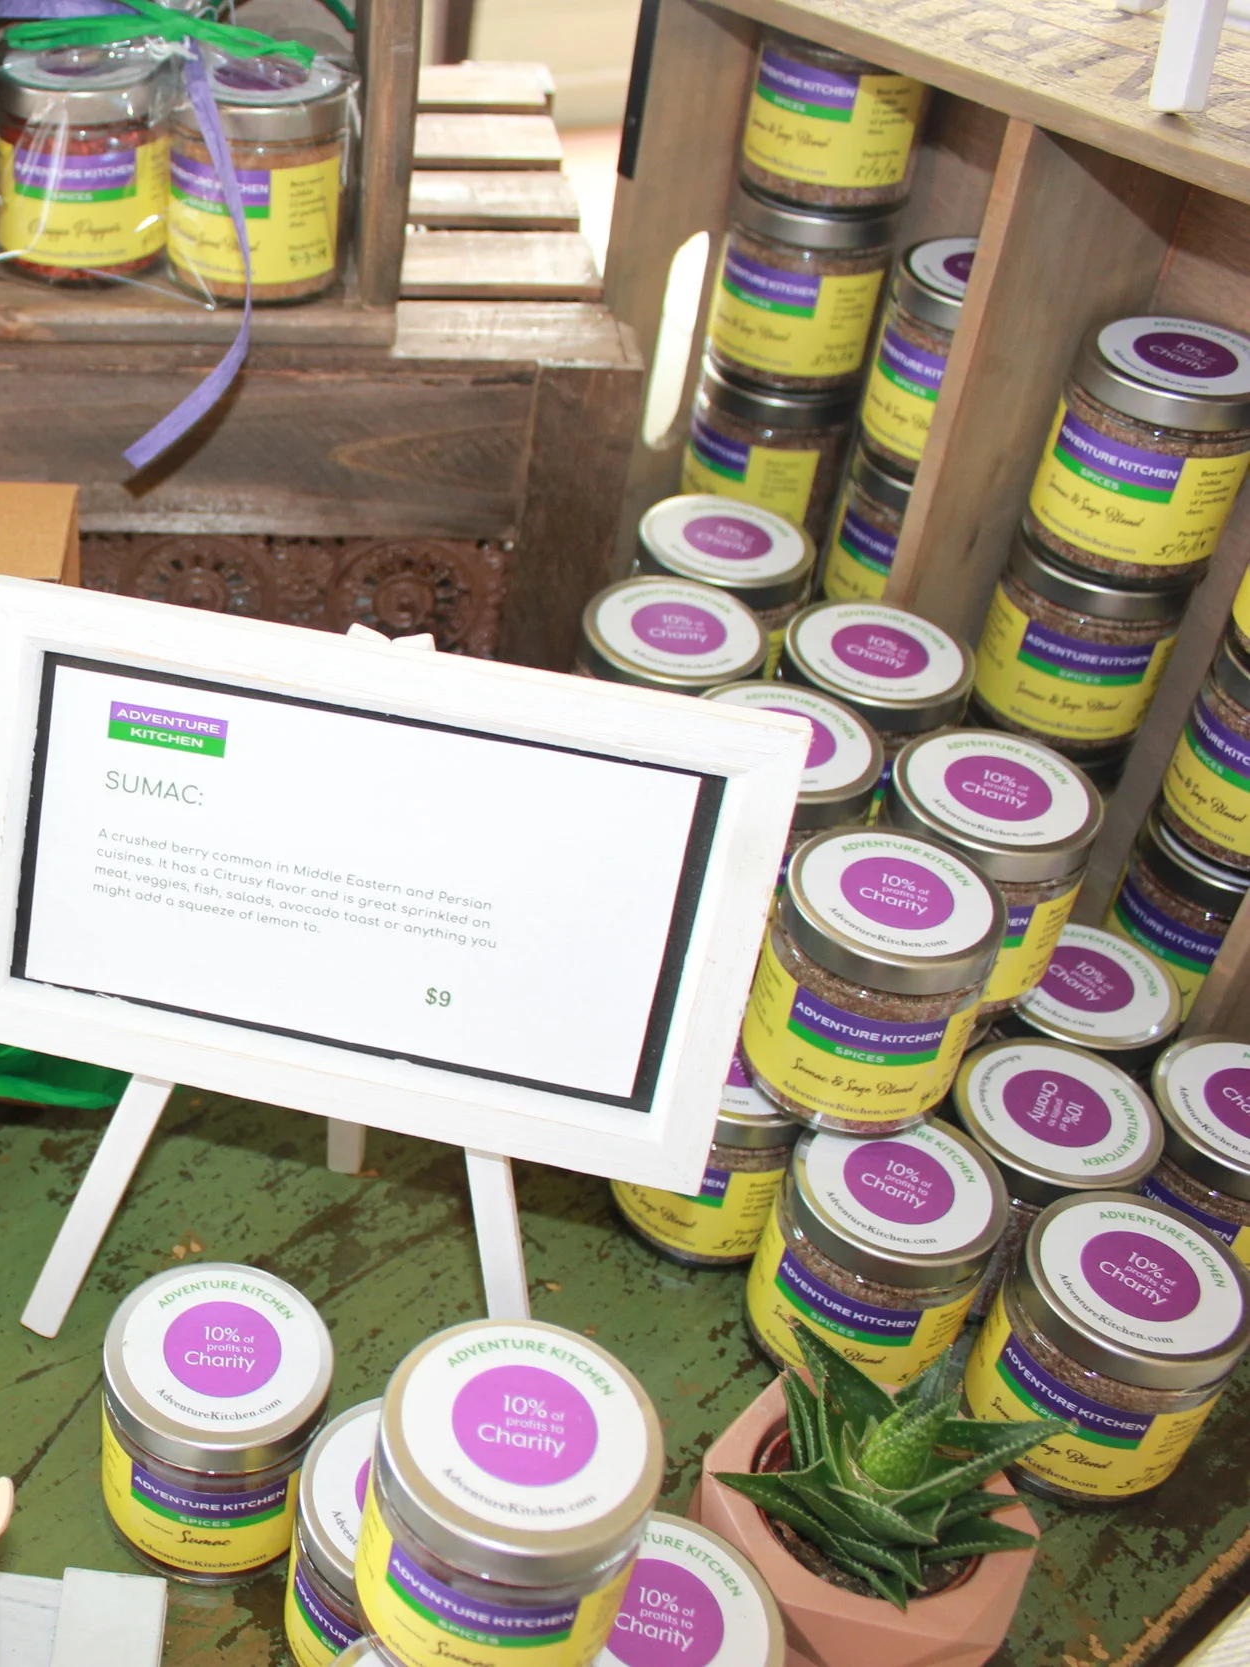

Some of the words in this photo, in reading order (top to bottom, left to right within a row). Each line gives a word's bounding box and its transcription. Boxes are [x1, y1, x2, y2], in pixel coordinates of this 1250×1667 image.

[803, 79, 856, 98] KITCHEN
[87, 163, 135, 178] KITCHEN
[767, 277, 818, 297] KITCHEN
[1149, 344, 1207, 371] Charity
[1061, 424, 1118, 466] ADVENTURE
[1118, 460, 1179, 480] KITCHEN
[1079, 467, 1120, 491] SPICES
[846, 643, 906, 670] Charity
[1025, 633, 1098, 665] ADVENTURE
[1099, 653, 1150, 667] KITCHEN
[117, 709, 220, 734] ADVENTURE
[130, 727, 204, 748] KITCHEN
[982, 769, 1017, 788] 10%
[1023, 752, 1070, 786] KITCHEN
[105, 771, 203, 805] SUMAC:
[960, 780, 1028, 809] Charity
[98, 828, 107, 839] A
[112, 832, 167, 850] crushed
[172, 842, 208, 860] berry
[212, 851, 271, 870] common
[276, 860, 288, 873] in
[293, 864, 341, 883] Middle
[346, 874, 401, 894] Eastern
[406, 887, 434, 900] and
[439, 890, 492, 911] Persian
[841, 839, 921, 855] ADVENTURE
[922, 851, 971, 888] KITCHEN
[159, 858, 167, 869] It
[171, 860, 196, 874] has
[200, 868, 208, 876] a
[213, 868, 262, 889] Citrusy
[266, 878, 306, 895] flavor
[311, 888, 339, 901] and
[343, 892, 354, 903] is
[358, 897, 397, 912] great
[401, 904, 468, 925] sprinkled
[472, 919, 490, 929] on
[882, 872, 916, 892] 10%
[882, 883, 915, 901] profits
[93, 882, 130, 898] might
[135, 890, 162, 904] add
[166, 898, 174, 906] a
[178, 899, 235, 918] squeeze
[239, 911, 254, 920] of
[257, 912, 299, 929] lemon
[303, 920, 321, 934] to.
[94, 865, 131, 881] meat,
[135, 874, 190, 893] veggies,
[195, 882, 221, 899] fish,
[226, 889, 275, 909] salads,
[279, 900, 339, 919] avocado
[344, 911, 380, 926] toast
[384, 919, 399, 930] or
[404, 923, 467, 946] anything
[471, 936, 497, 949] you
[859, 886, 929, 916] Charity
[425, 987, 452, 1007] $9
[795, 1001, 880, 1042] ADVENTURE
[881, 1030, 944, 1044] KITCHEN
[834, 1045, 886, 1064] SPICES
[1025, 1081, 1059, 1124] Charity
[886, 1159, 919, 1183] 10%
[935, 1139, 976, 1184] KITCHEN
[861, 1172, 926, 1210] Charity
[885, 1171, 916, 1191] profits
[1099, 1210, 1185, 1241] ADVENTURE
[1184, 1238, 1227, 1289] KITCHEN
[1127, 1251, 1164, 1279] 10%
[1099, 1260, 1169, 1307] Charity
[1124, 1265, 1158, 1288] profits
[158, 1280, 239, 1309] ADVENTURE
[241, 1282, 293, 1320] KITCHEN
[781, 1261, 852, 1318] ADVENTURE
[854, 1311, 917, 1329] KITCHEN
[1059, 1272, 1175, 1345] AdventureKitchen.com
[204, 1326, 241, 1343] 10%
[206, 1342, 240, 1353] profits
[184, 1350, 256, 1373] Charity
[446, 1337, 547, 1368] ADVENTURE
[551, 1346, 615, 1396] KITCHEN
[156, 1387, 282, 1421] AdventureKitchen.com
[1005, 1346, 1077, 1413] ADVENTURE
[1077, 1408, 1148, 1432] KITCHEN
[503, 1394, 547, 1419] 10%
[477, 1421, 566, 1458] Charity
[506, 1416, 545, 1432] profits
[134, 1474, 221, 1511] ADVENTURE
[222, 1488, 286, 1511] KITCHEN
[442, 1466, 598, 1518] AdventureKitchen.com
[179, 1515, 231, 1528] SPICES
[685, 1538, 742, 1598] KITCHEN
[390, 1558, 489, 1625] ADVENTURE
[492, 1611, 575, 1630] KITCHEN
[639, 1586, 679, 1613] 10%
[640, 1606, 678, 1624] profits
[614, 1611, 694, 1652] Charity
